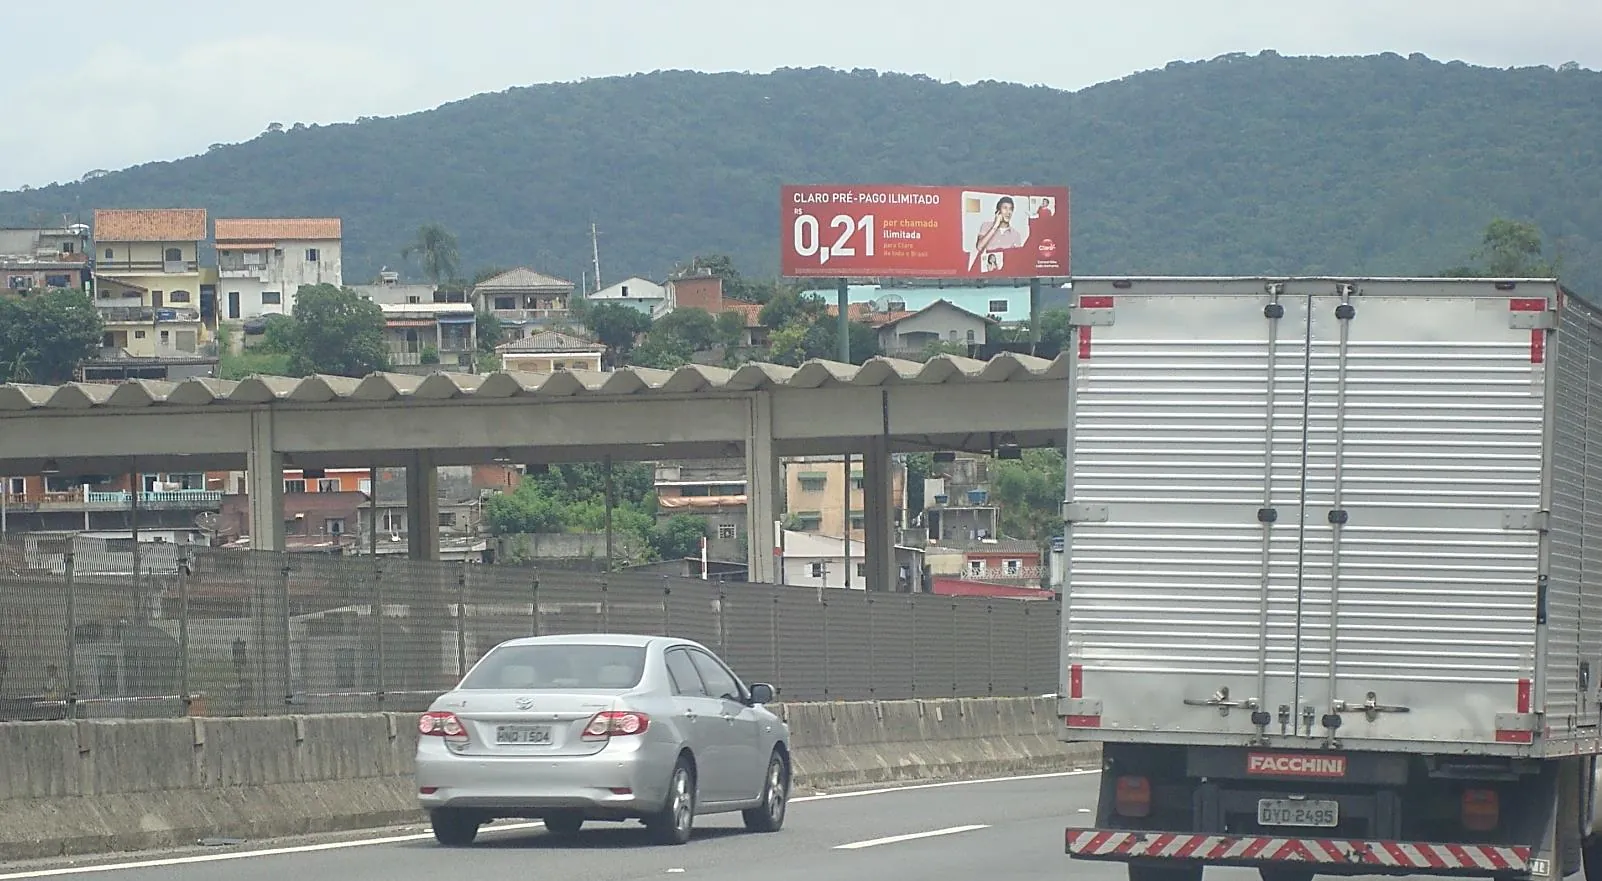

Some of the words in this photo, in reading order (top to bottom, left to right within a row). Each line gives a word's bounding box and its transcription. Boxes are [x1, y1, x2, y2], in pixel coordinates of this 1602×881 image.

[793, 192, 829, 203] CLARO
[832, 190, 887, 204] PRÉ-PAGO
[888, 193, 940, 204] ILIMITADO
[883, 219, 898, 228] por
[900, 218, 939, 228] chamada
[794, 214, 874, 265] 0,21
[883, 229, 921, 239] ilimitada
[1250, 756, 1343, 773] FACCHINI
